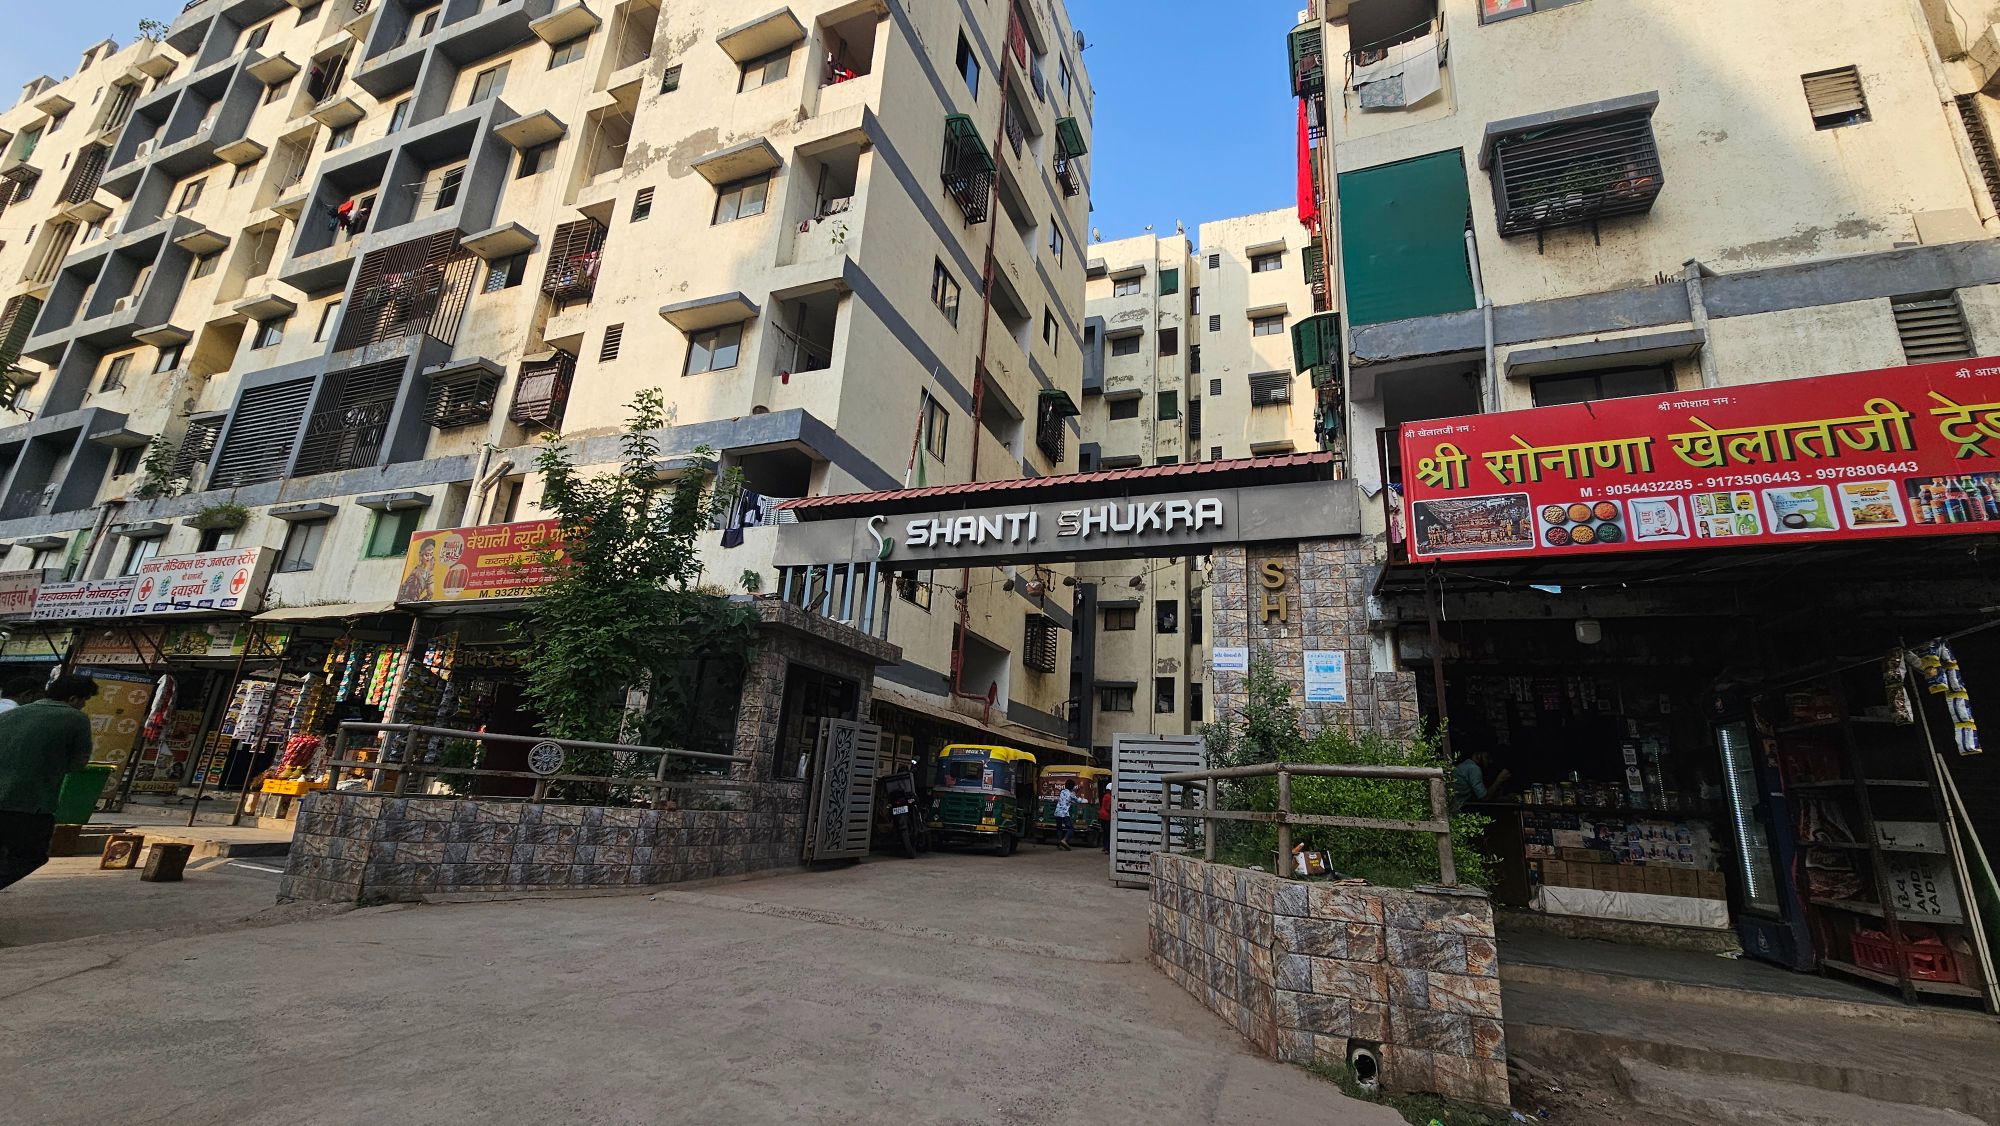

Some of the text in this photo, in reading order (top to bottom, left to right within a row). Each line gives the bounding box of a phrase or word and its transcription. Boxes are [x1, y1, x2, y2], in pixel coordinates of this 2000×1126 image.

[1955, 367, 1970, 379] श्री
[1658, 401, 1671, 413] श्री
[1674, 397, 1709, 411] गणेशाय
[1404, 427, 1415, 440] श्री
[1417, 424, 1453, 438] खेलातजी
[1415, 442, 1468, 490] श्री
[1482, 434, 1653, 485] सोनाणा
[1669, 397, 1916, 468] खेलातजी
[1580, 486, 1592, 497] M
[1605, 478, 1692, 495] 9054432285
[1707, 470, 1801, 490] 9173506443
[1816, 461, 1918, 482] 9978806443
[906, 511, 1038, 549] SHANTI
[1056, 497, 1223, 540] SHUKRA
[467, 527, 511, 549] वैशाली
[485, 555, 514, 567] कटलरी
[37, 587, 86, 602] महाकाली
[86, 584, 133, 602] मोबाईल
